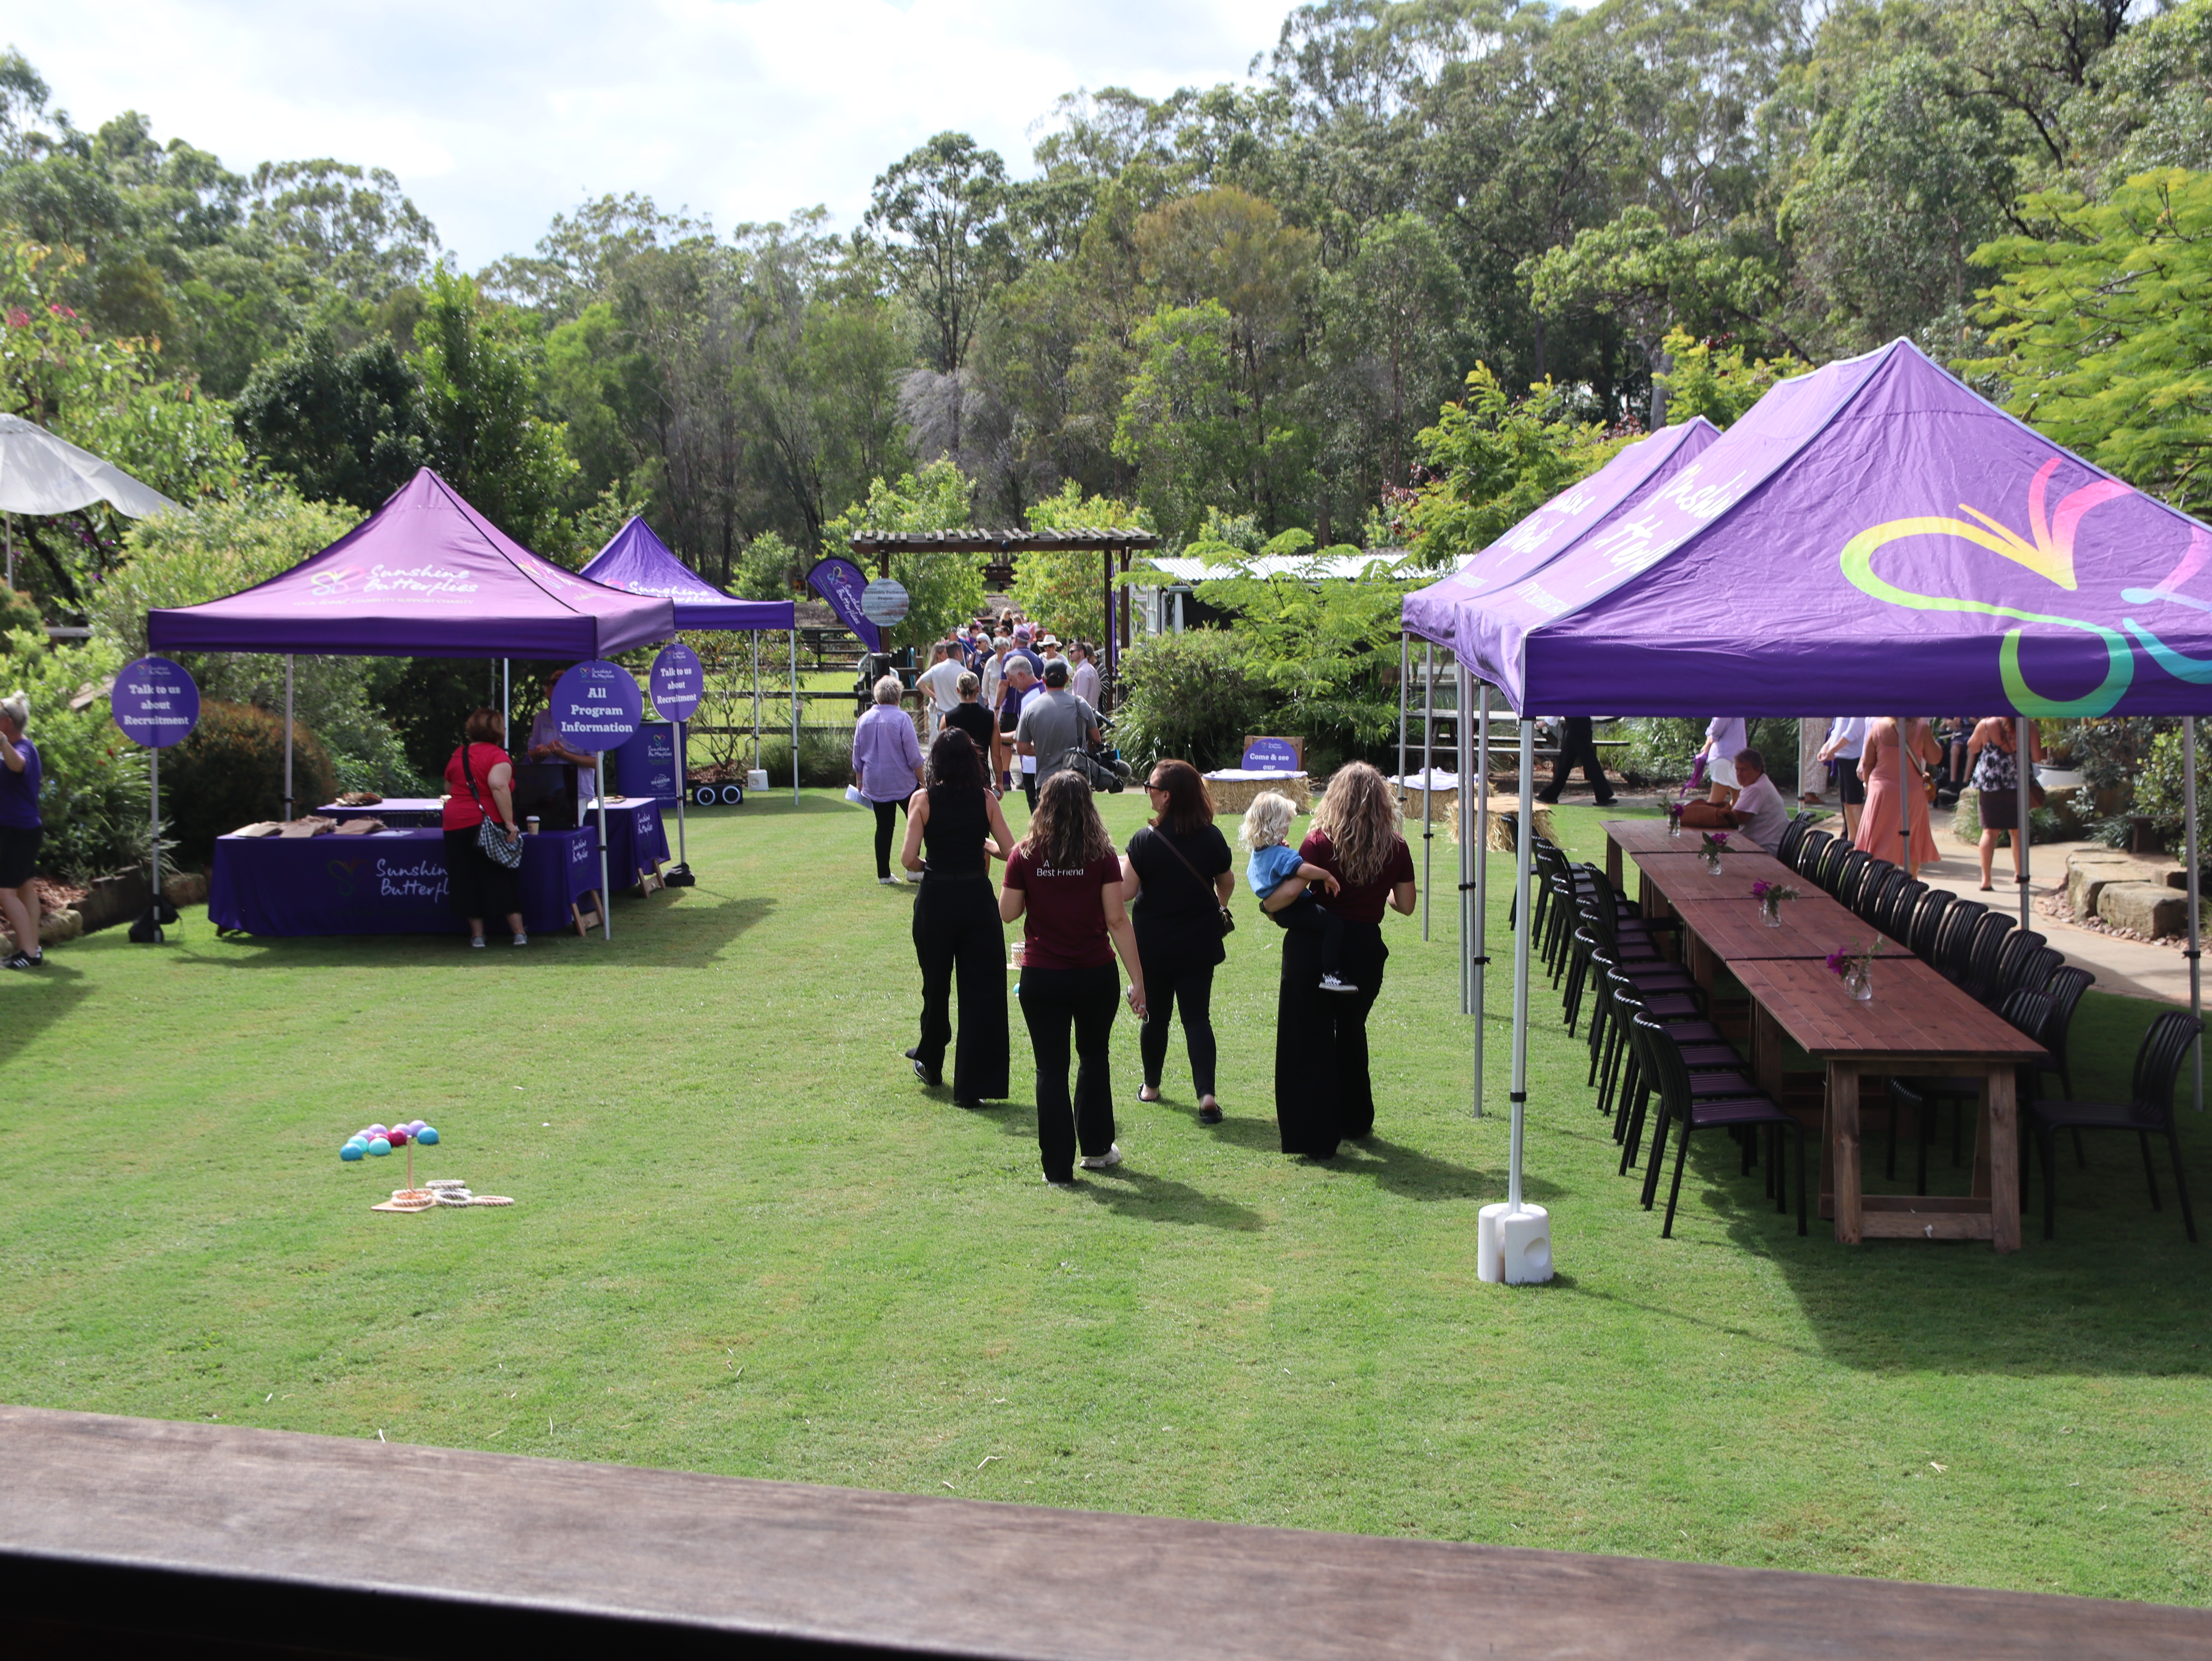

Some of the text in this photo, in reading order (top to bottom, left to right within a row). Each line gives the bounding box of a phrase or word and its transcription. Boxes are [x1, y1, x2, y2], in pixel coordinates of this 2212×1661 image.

[365, 564, 470, 580] Sunshine
[364, 578, 479, 597] Butterflies
[627, 581, 709, 596] Sunshine
[835, 588, 861, 625] Butterflies
[660, 667, 676, 677] Talk
[128, 684, 181, 694] Talk to us
[667, 681, 685, 690] about
[587, 687, 607, 698] All
[140, 699, 171, 710] about
[657, 693, 697, 705] Recruitment
[570, 704, 624, 718] Program
[123, 715, 190, 725] Recruitment
[561, 721, 633, 733] Information
[1250, 752, 1270, 761] Come
[376, 858, 448, 877] Sunshin
[1043, 859, 1050, 868] A
[1037, 867, 1084, 877] Best Friend
[381, 877, 449, 903] Butterfl
